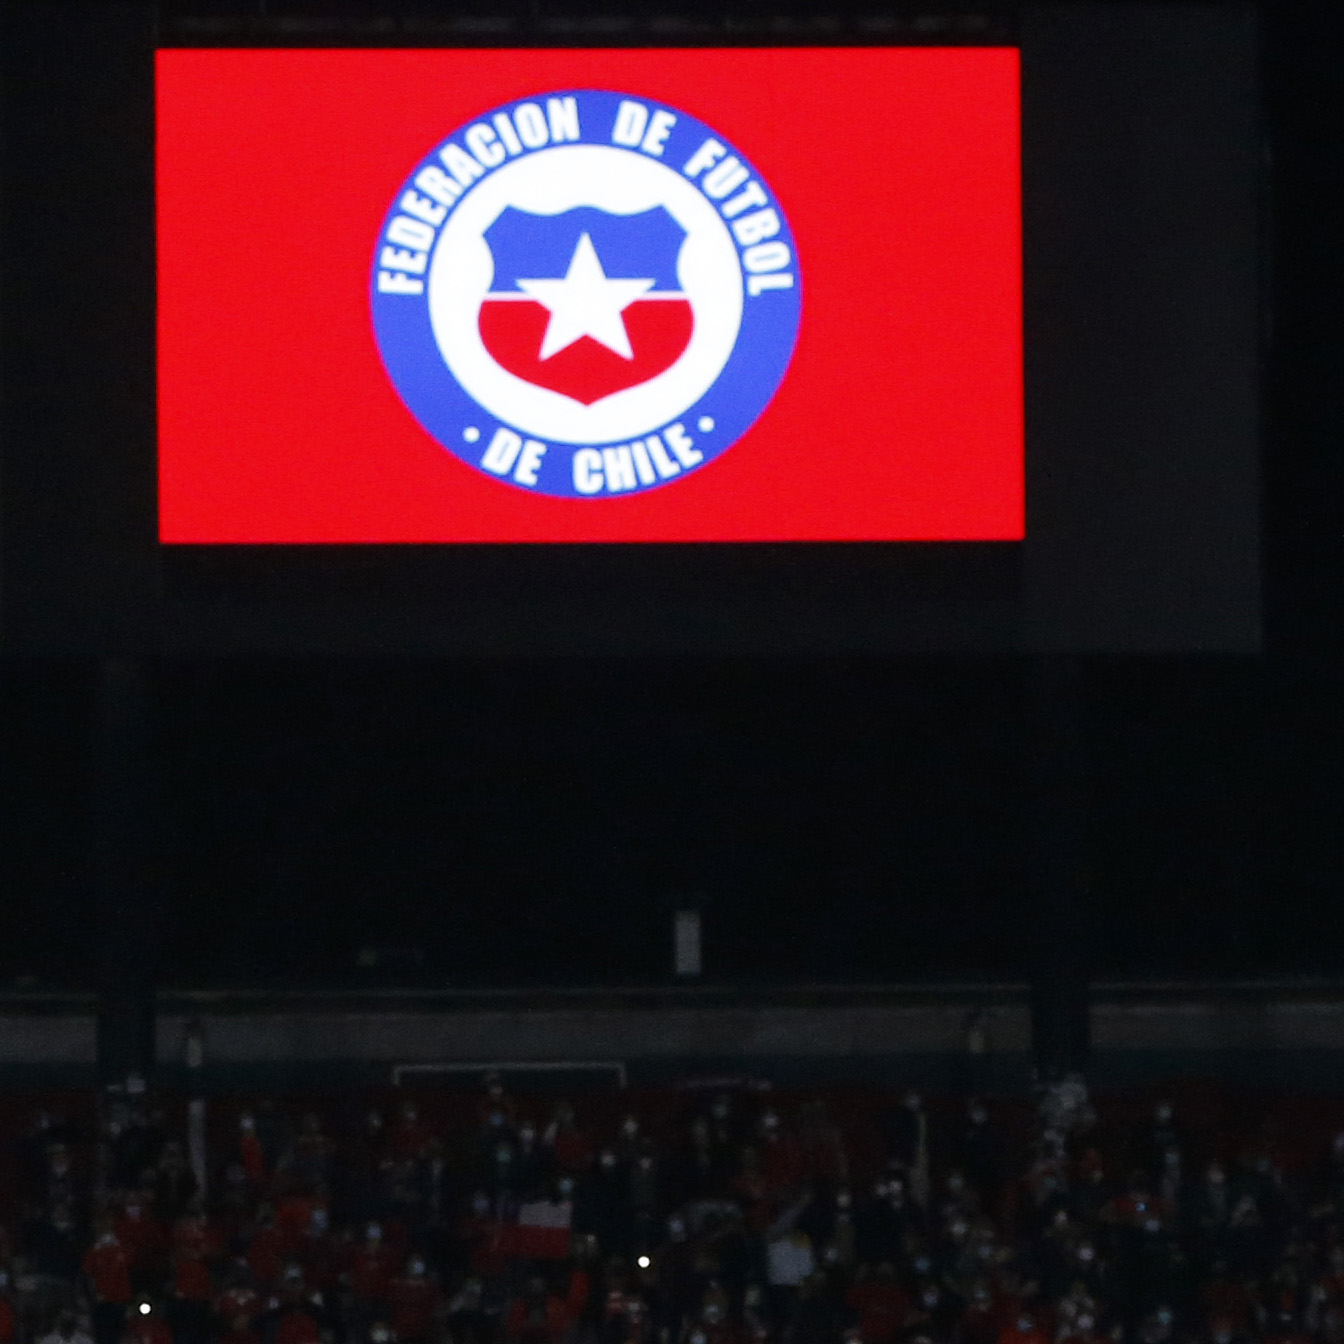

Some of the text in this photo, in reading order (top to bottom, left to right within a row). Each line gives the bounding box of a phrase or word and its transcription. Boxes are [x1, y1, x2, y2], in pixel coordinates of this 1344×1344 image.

[377, 97, 794, 297] FEDERACION DE FUTBOL
[481, 422, 704, 494] DE CHILE
